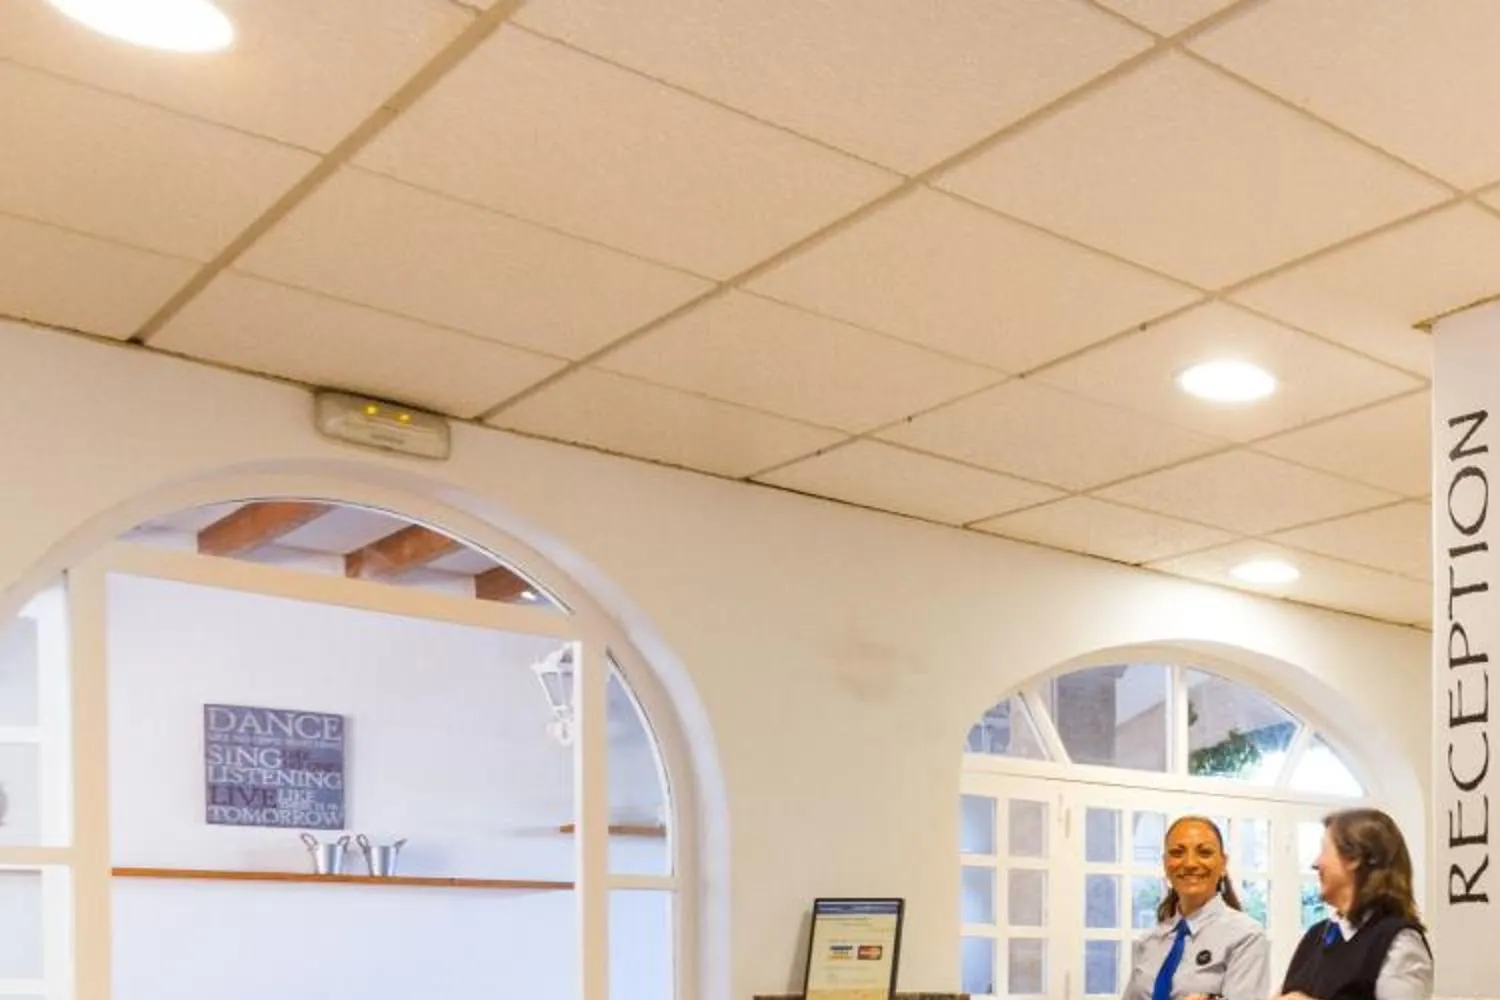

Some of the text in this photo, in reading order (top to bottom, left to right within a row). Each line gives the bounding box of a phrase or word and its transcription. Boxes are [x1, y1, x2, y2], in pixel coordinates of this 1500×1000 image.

[1448, 409, 1489, 904] RECEPTION
[207, 706, 342, 741] DANCE
[207, 743, 282, 769] SING
[207, 764, 342, 789] LISTENING
[210, 784, 277, 809] LIVE
[207, 804, 341, 827] TOMORROW
